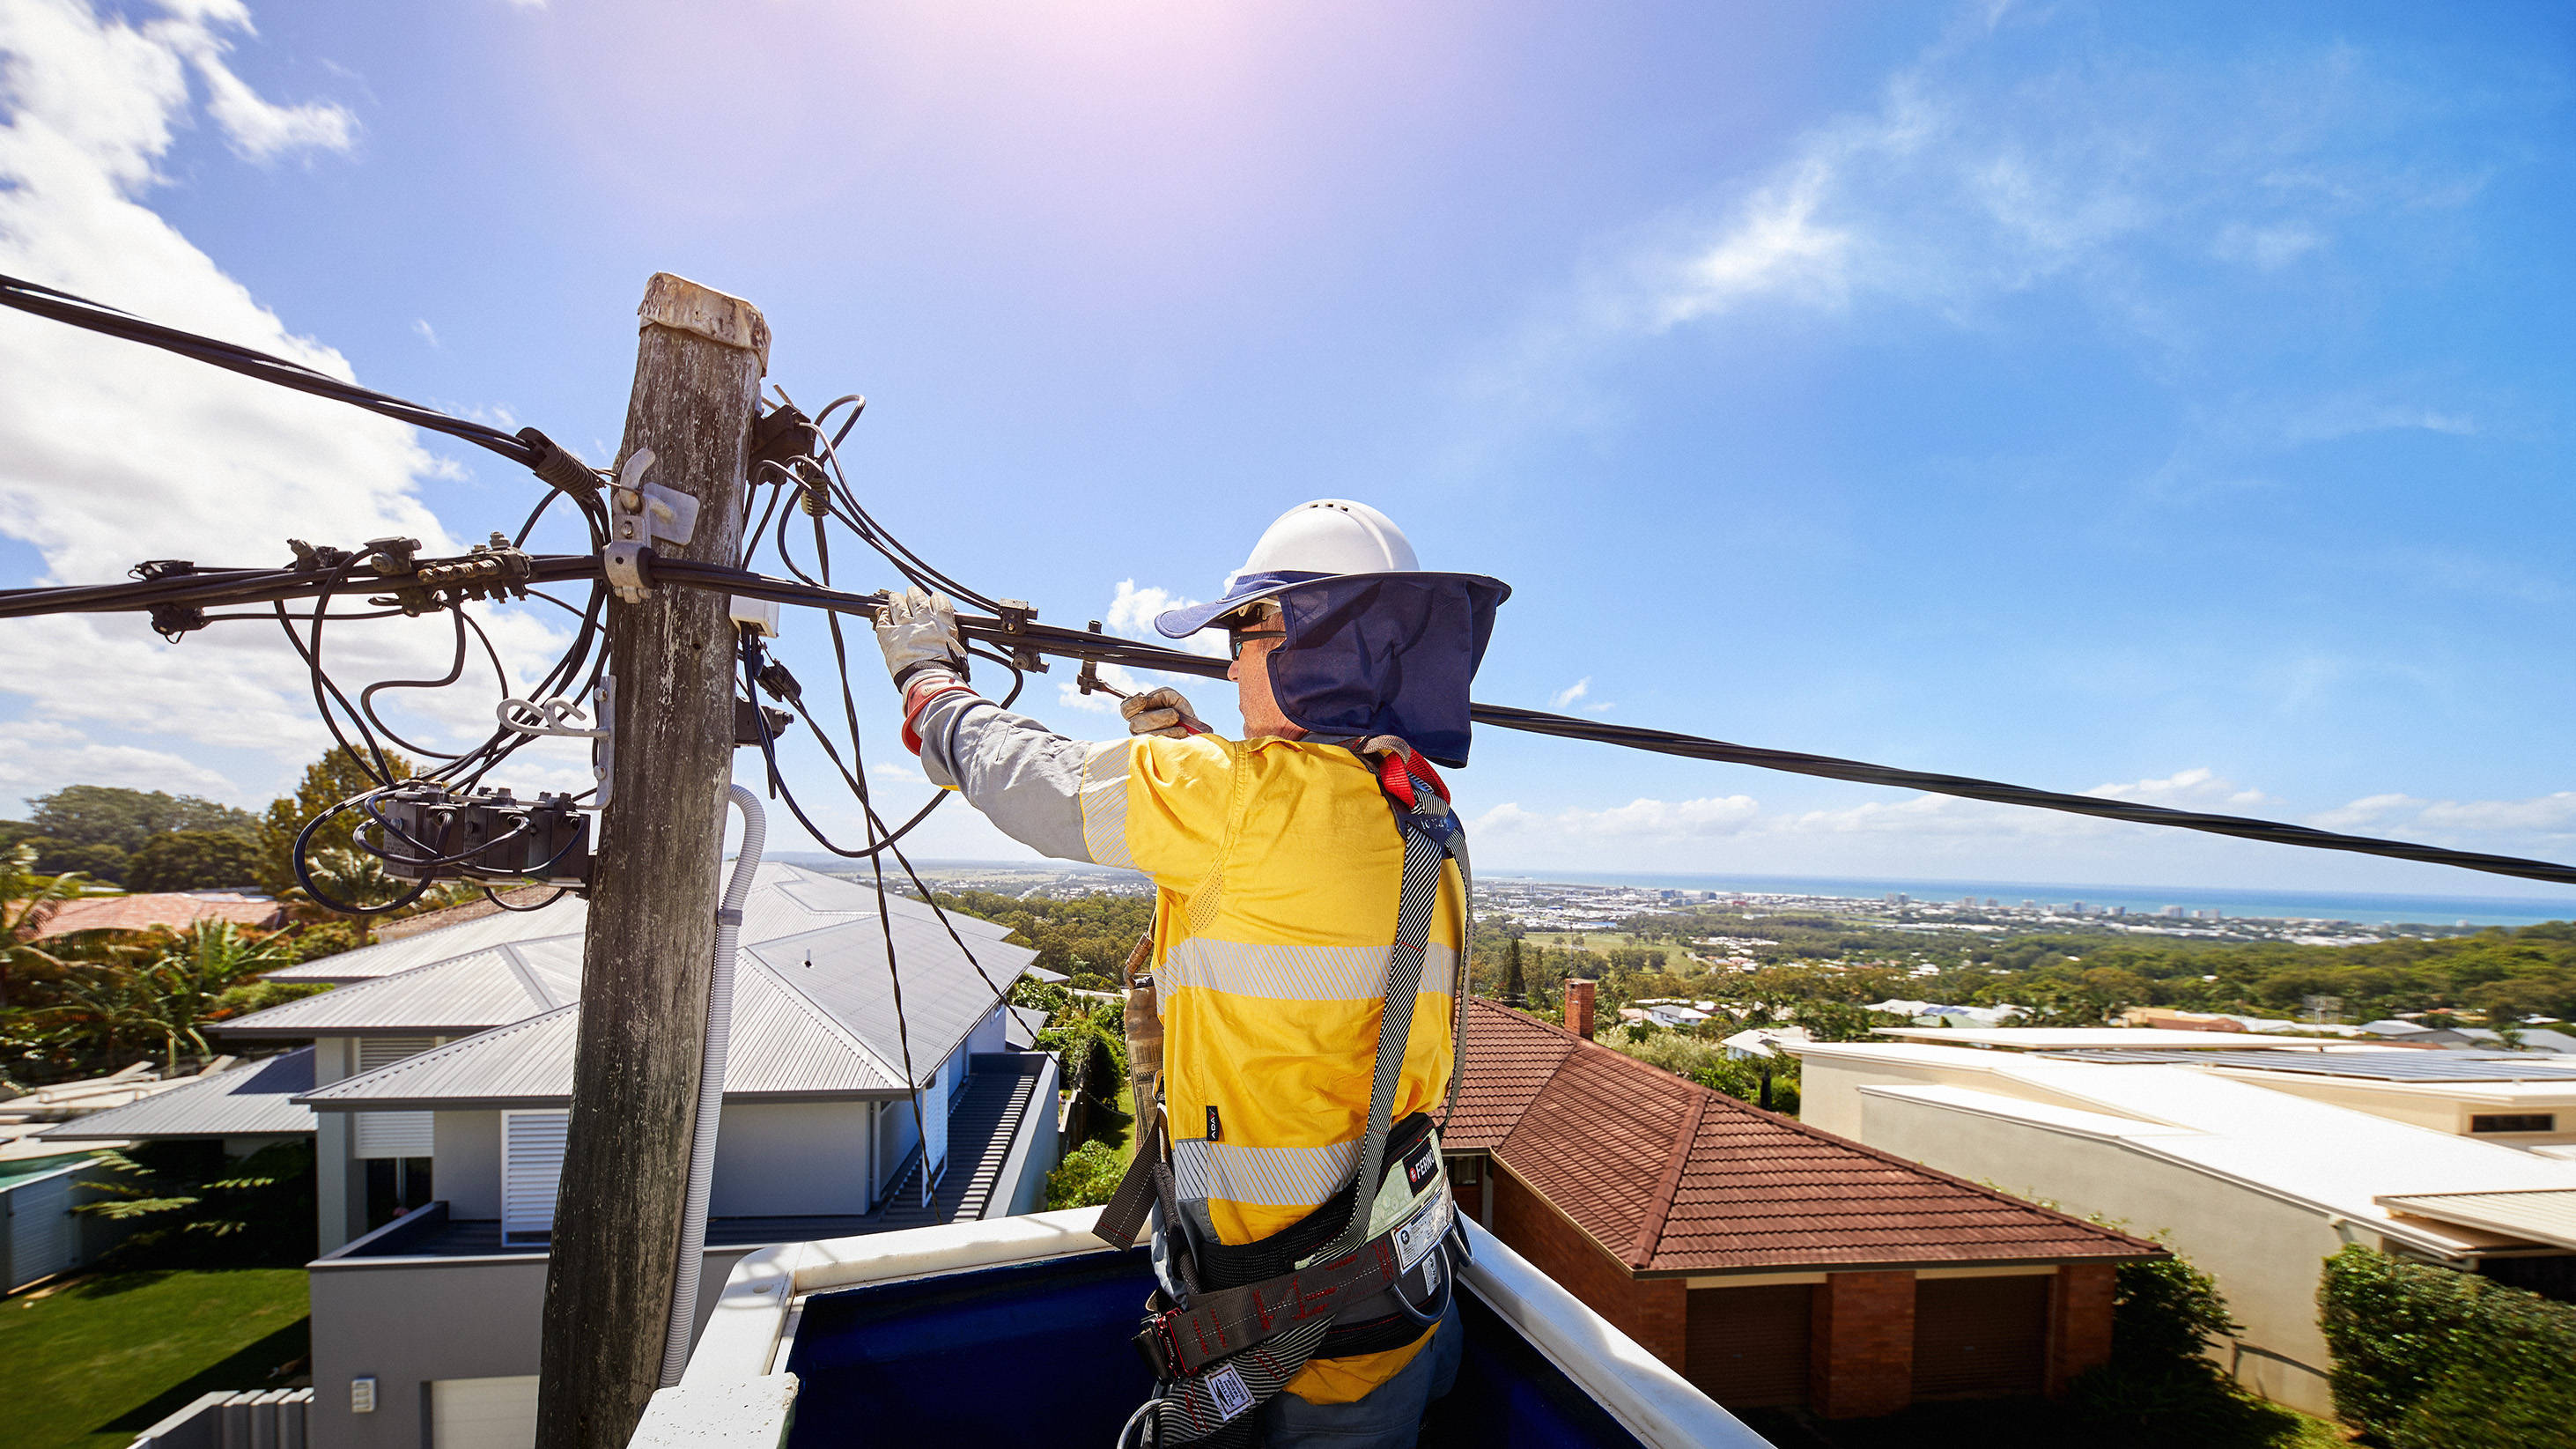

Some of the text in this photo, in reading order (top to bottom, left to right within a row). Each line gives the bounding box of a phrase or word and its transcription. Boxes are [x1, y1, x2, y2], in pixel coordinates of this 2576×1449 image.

[1415, 1149, 1435, 1179] FERNO
[1217, 1379, 1227, 1394] STRAP
[1225, 1394, 1235, 1407] POLE
